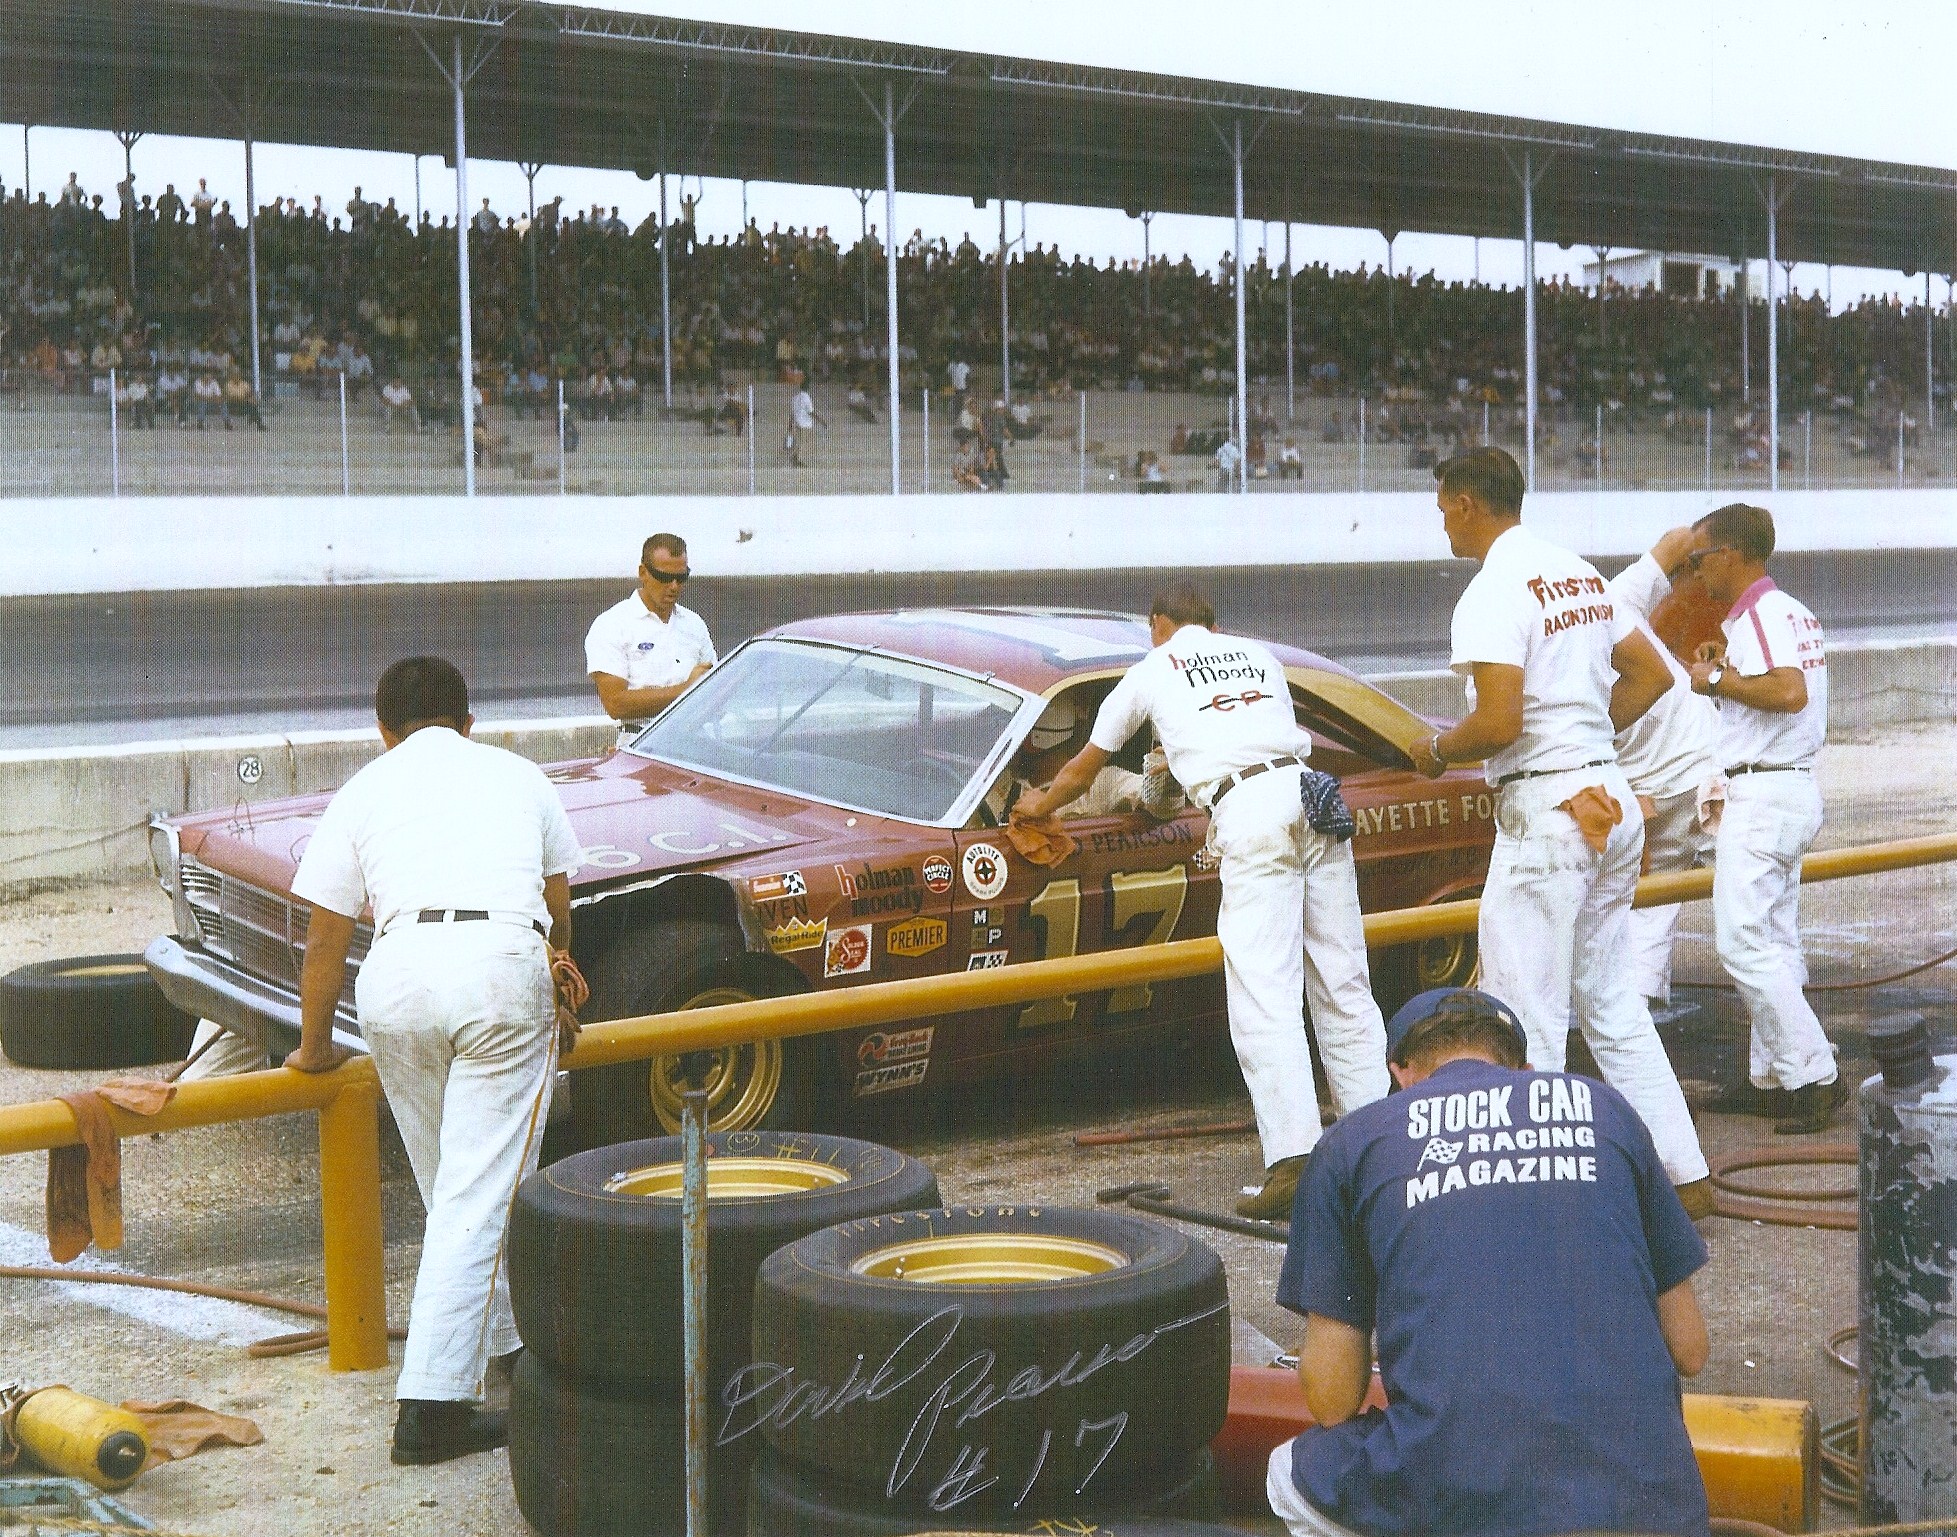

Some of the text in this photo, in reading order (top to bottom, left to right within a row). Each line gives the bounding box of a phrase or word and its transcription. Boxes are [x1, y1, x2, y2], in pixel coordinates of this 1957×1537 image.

[242, 760, 260, 778] 28
[1355, 799, 1450, 836] AYETTE
[966, 846, 1000, 865] AUTOLITE
[923, 864, 951, 876] PERFECT
[926, 870, 950, 882] CIRCLE
[974, 910, 987, 924] M
[890, 925, 944, 951] PREMIER
[988, 928, 1002, 944] P
[1018, 864, 1188, 1029] 17
[1407, 1078, 1594, 1140] STOCK CAR
[1468, 1126, 1596, 1153] RACING
[1406, 1155, 1598, 1208] MAGAZINE
